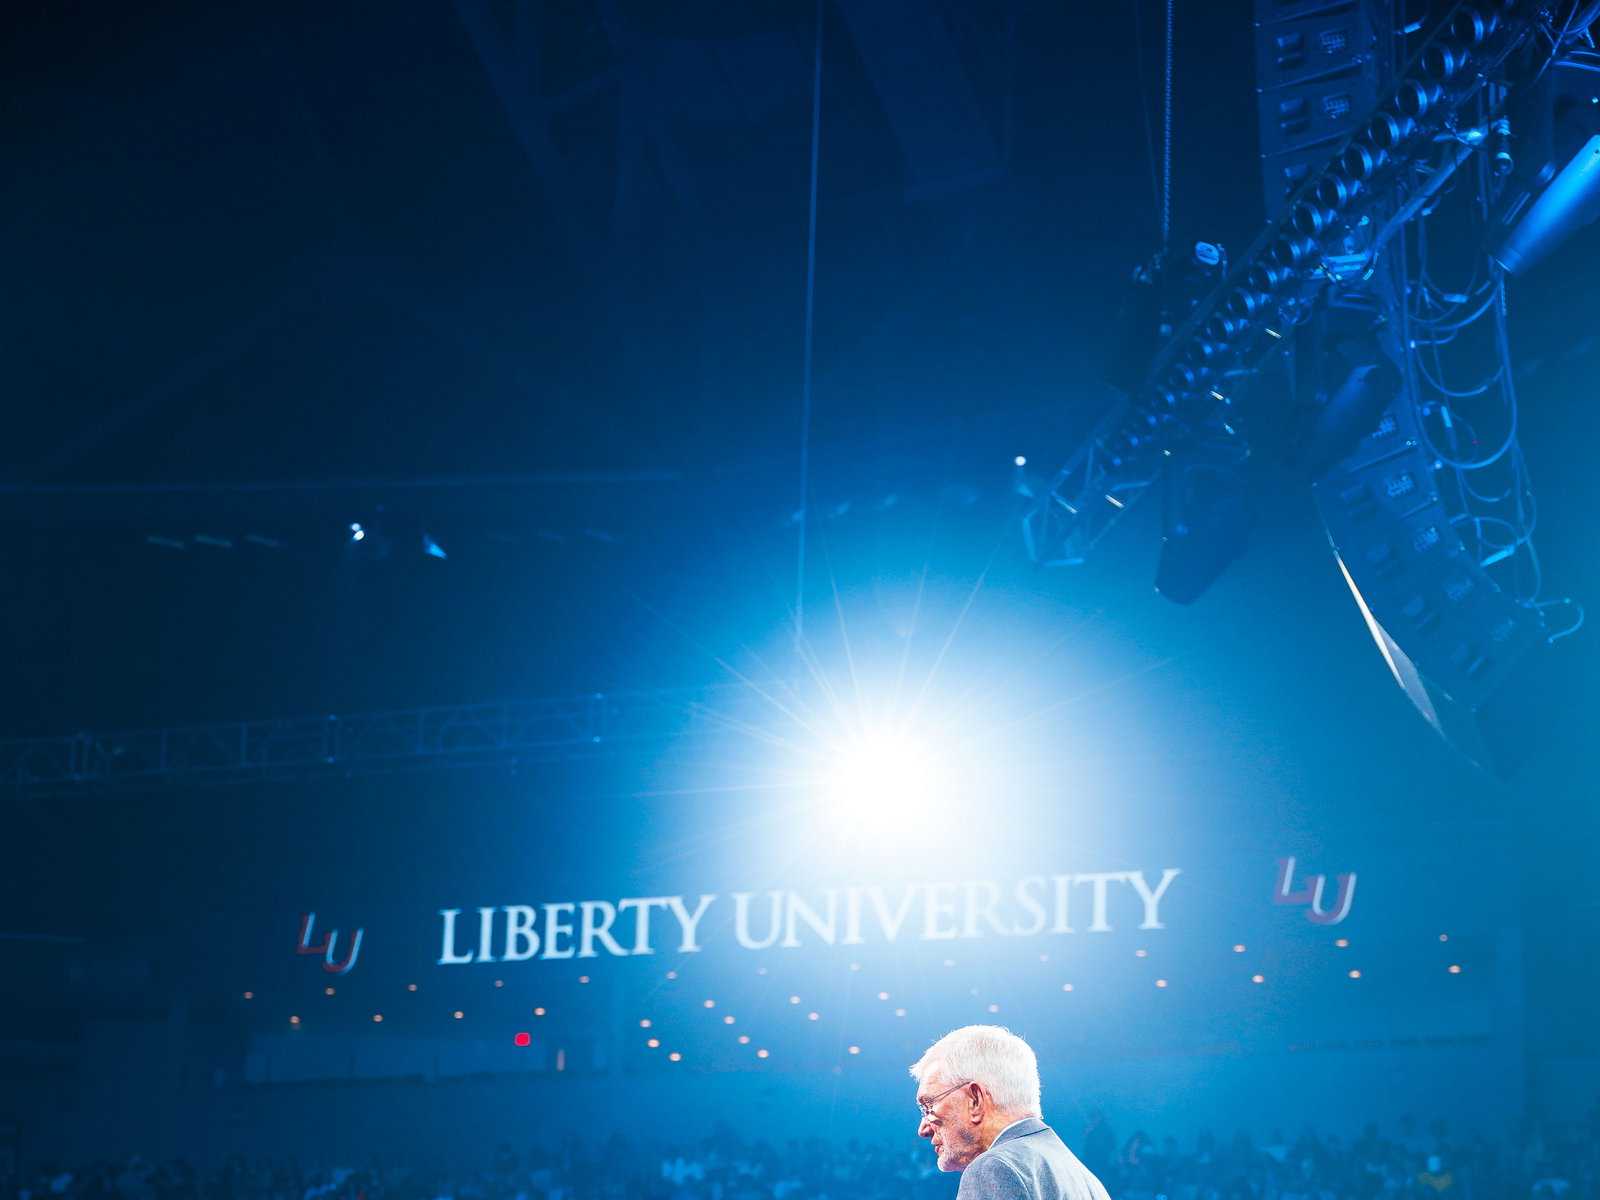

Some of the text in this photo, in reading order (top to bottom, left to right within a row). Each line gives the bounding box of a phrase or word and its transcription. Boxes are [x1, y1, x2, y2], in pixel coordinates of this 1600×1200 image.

[437, 868, 1181, 965] LIBERTY UNIVERSITY
[1274, 855, 1357, 926] LU
[297, 911, 364, 974] LU
